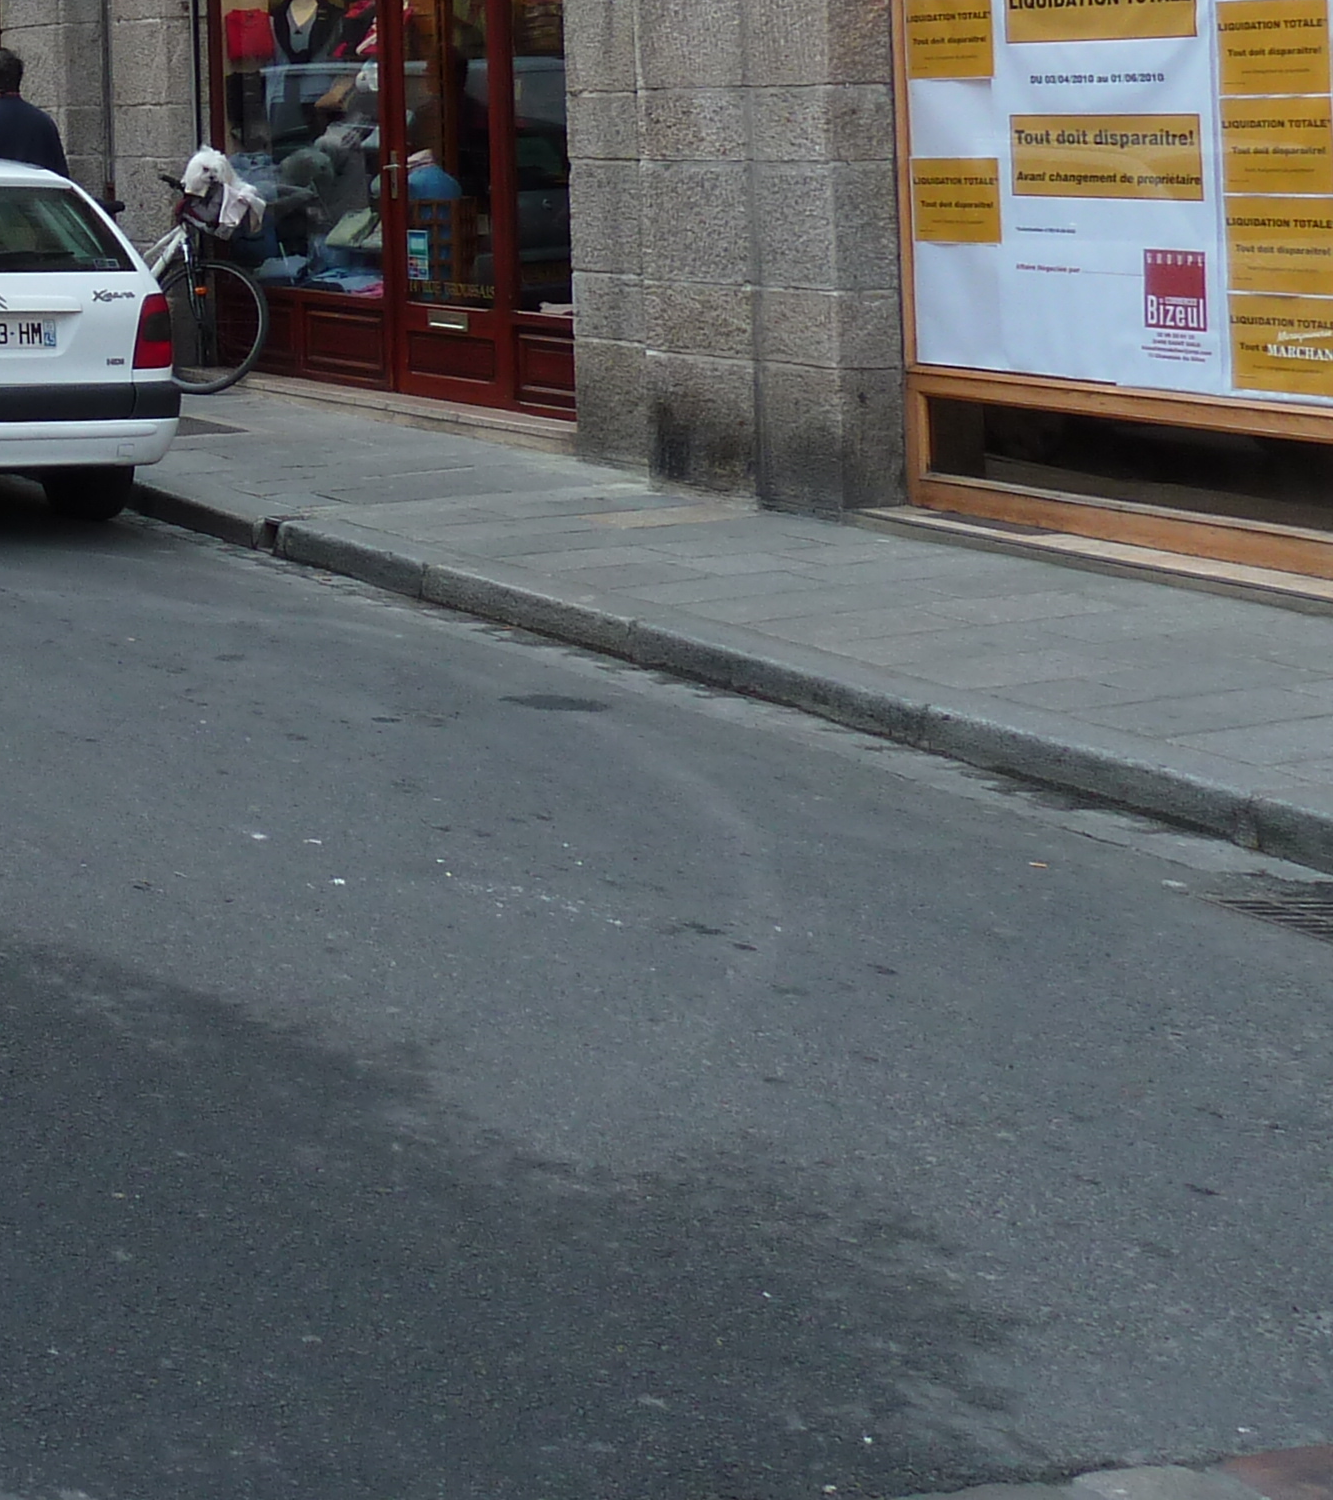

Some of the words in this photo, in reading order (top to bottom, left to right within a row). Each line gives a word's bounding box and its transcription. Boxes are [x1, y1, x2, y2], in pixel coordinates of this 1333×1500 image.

[1217, 19, 1281, 32] LIQUIDATION
[1015, 130, 1050, 145] Tout
[1056, 129, 1088, 145] doit
[1016, 171, 1046, 182] Avant
[1048, 171, 1117, 186] changement
[1119, 174, 1134, 184] de
[1137, 174, 1202, 187] propriétaire
[1146, 252, 1203, 267] GROUPE
[1147, 294, 1204, 329] Bizeul
